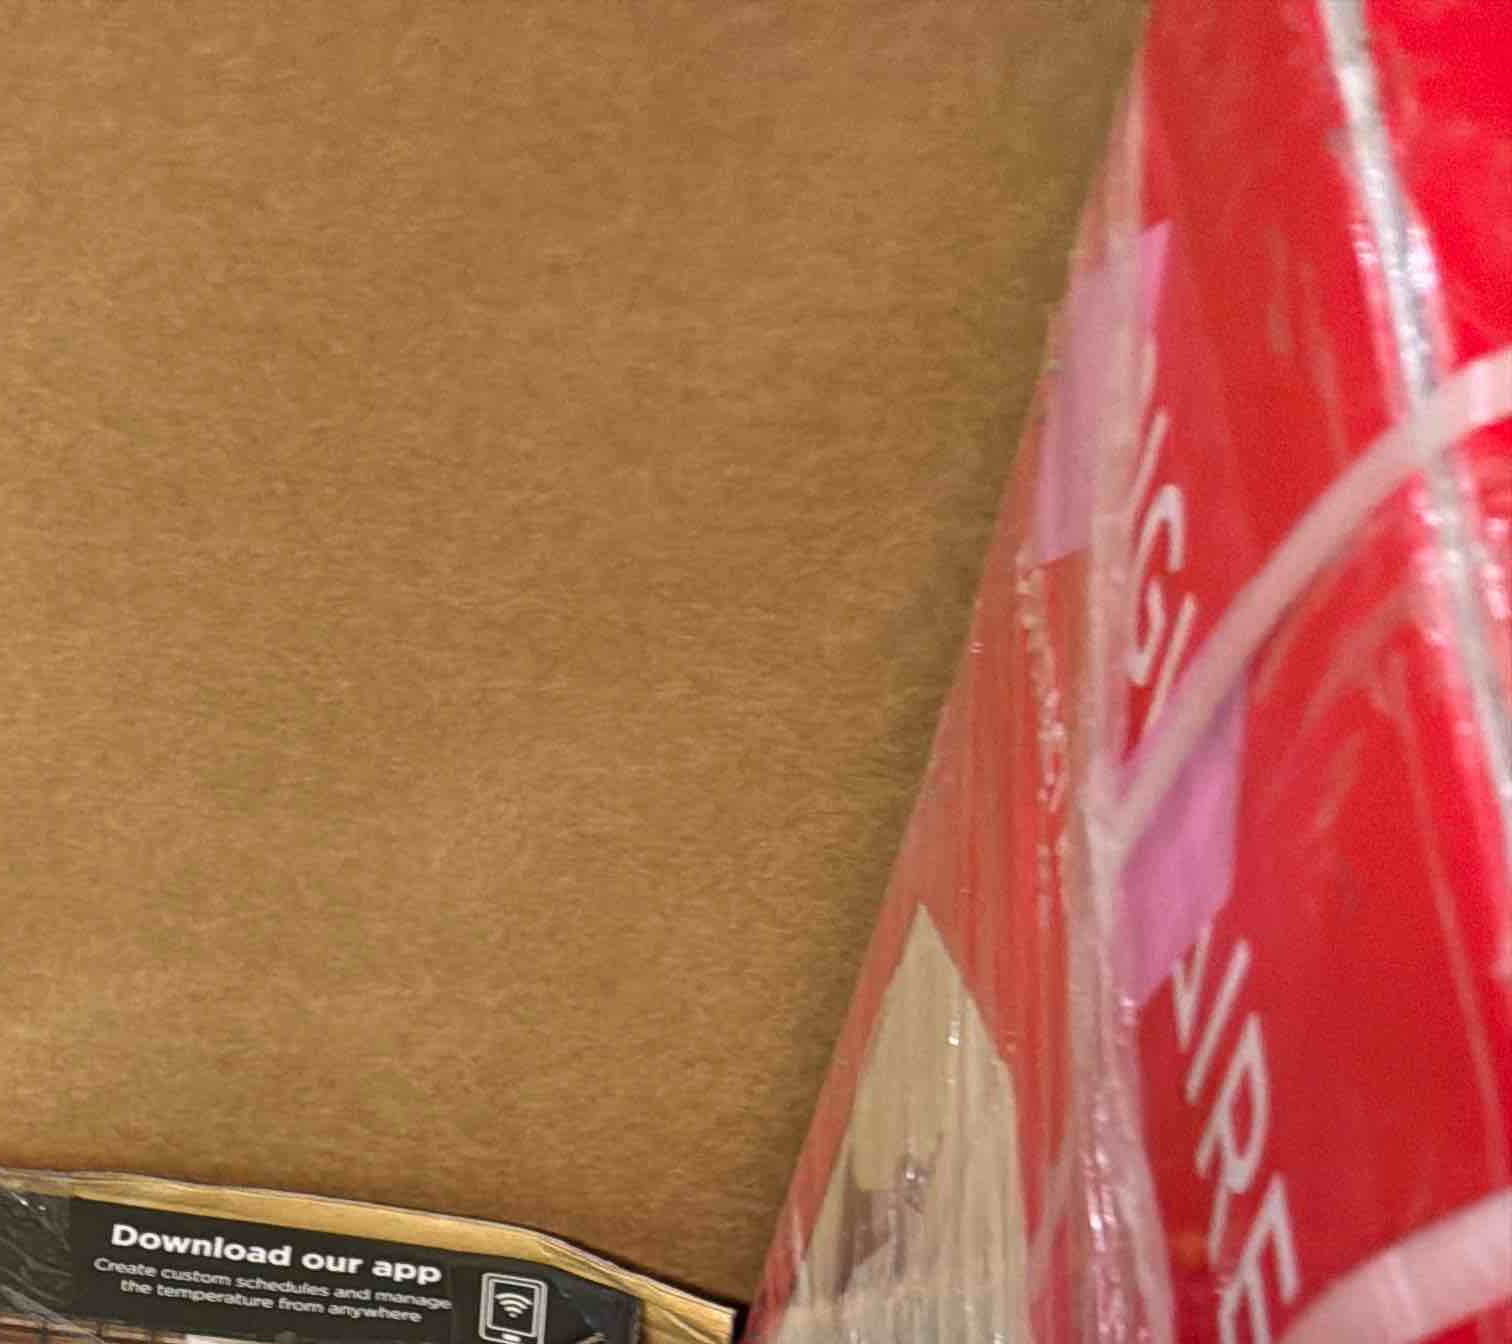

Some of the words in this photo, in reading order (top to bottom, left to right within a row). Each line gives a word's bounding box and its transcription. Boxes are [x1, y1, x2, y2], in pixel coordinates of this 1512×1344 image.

[110, 1222, 293, 1268] Download
[300, 1251, 363, 1275] our
[371, 1260, 443, 1285] app
[93, 1257, 157, 1279] Create
[160, 1266, 232, 1287] custom
[235, 1274, 330, 1298] schedules
[333, 1284, 372, 1302] and
[375, 1288, 453, 1311] manage
[120, 1278, 153, 1296] the
[156, 1283, 274, 1310] temperature
[278, 1296, 325, 1315] from
[327, 1301, 424, 1324] anywhere
